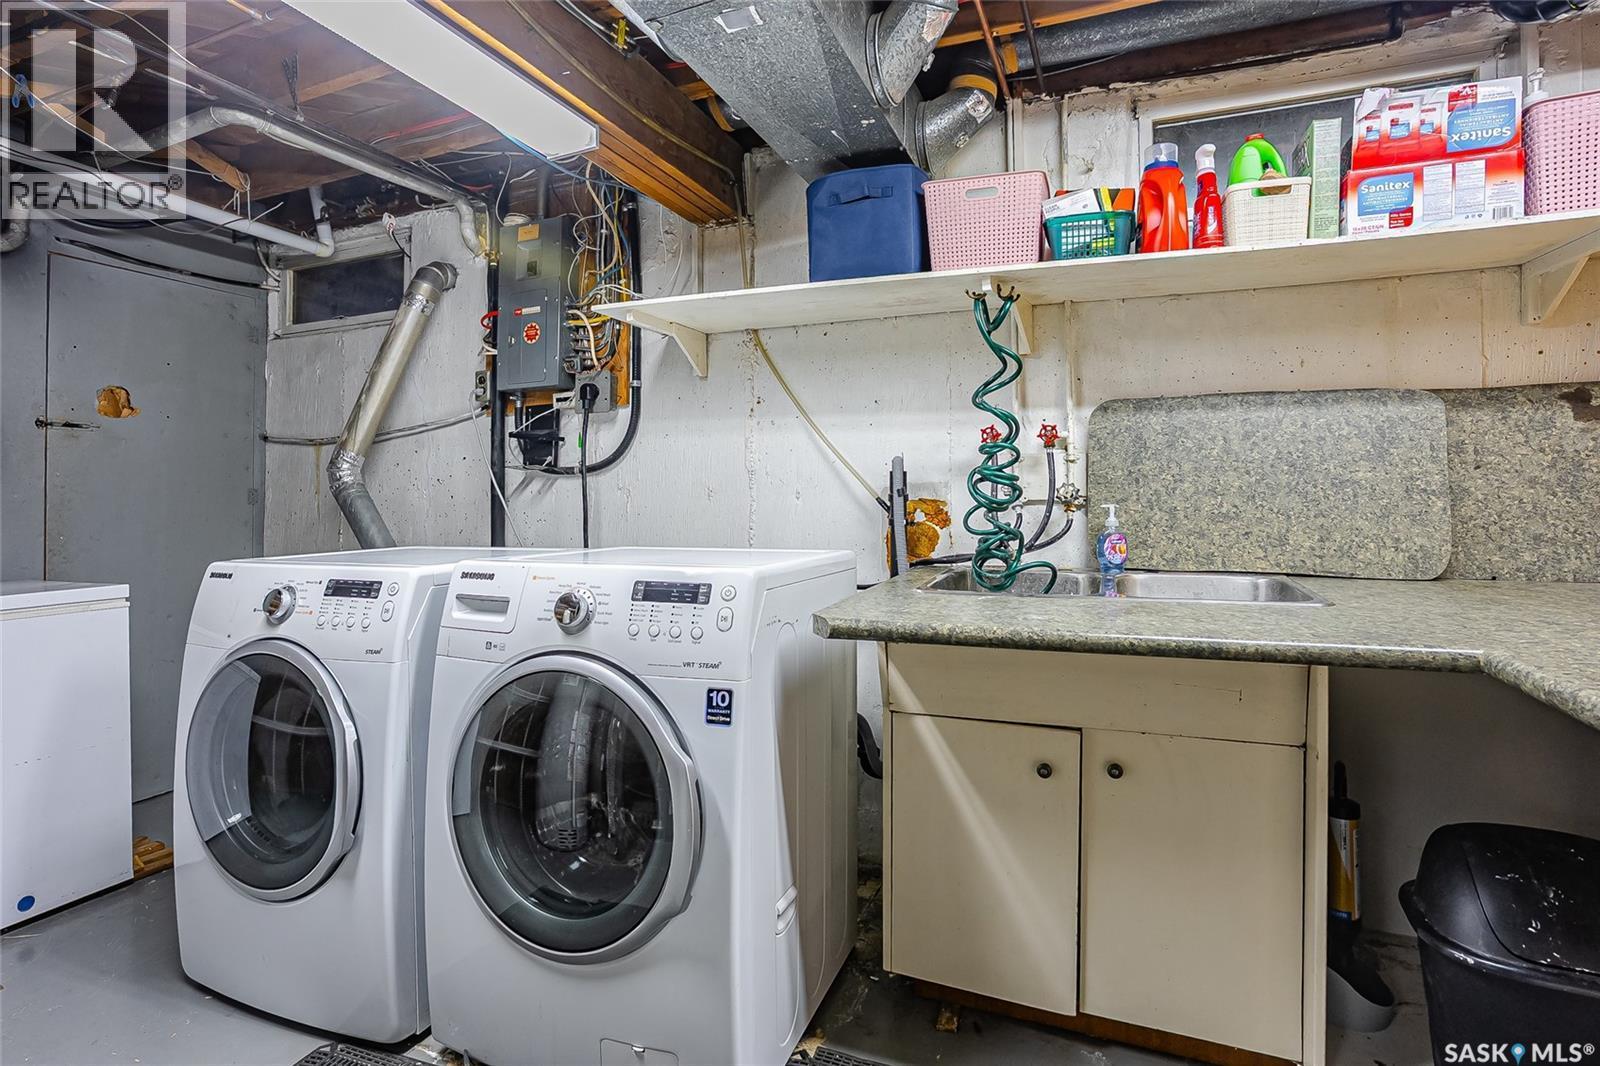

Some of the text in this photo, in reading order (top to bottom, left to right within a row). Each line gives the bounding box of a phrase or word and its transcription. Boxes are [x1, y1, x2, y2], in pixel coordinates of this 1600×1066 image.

[1451, 126, 1512, 143] Sanitex
[1360, 181, 1410, 194] Sanitex
[709, 690, 730, 707] 10
